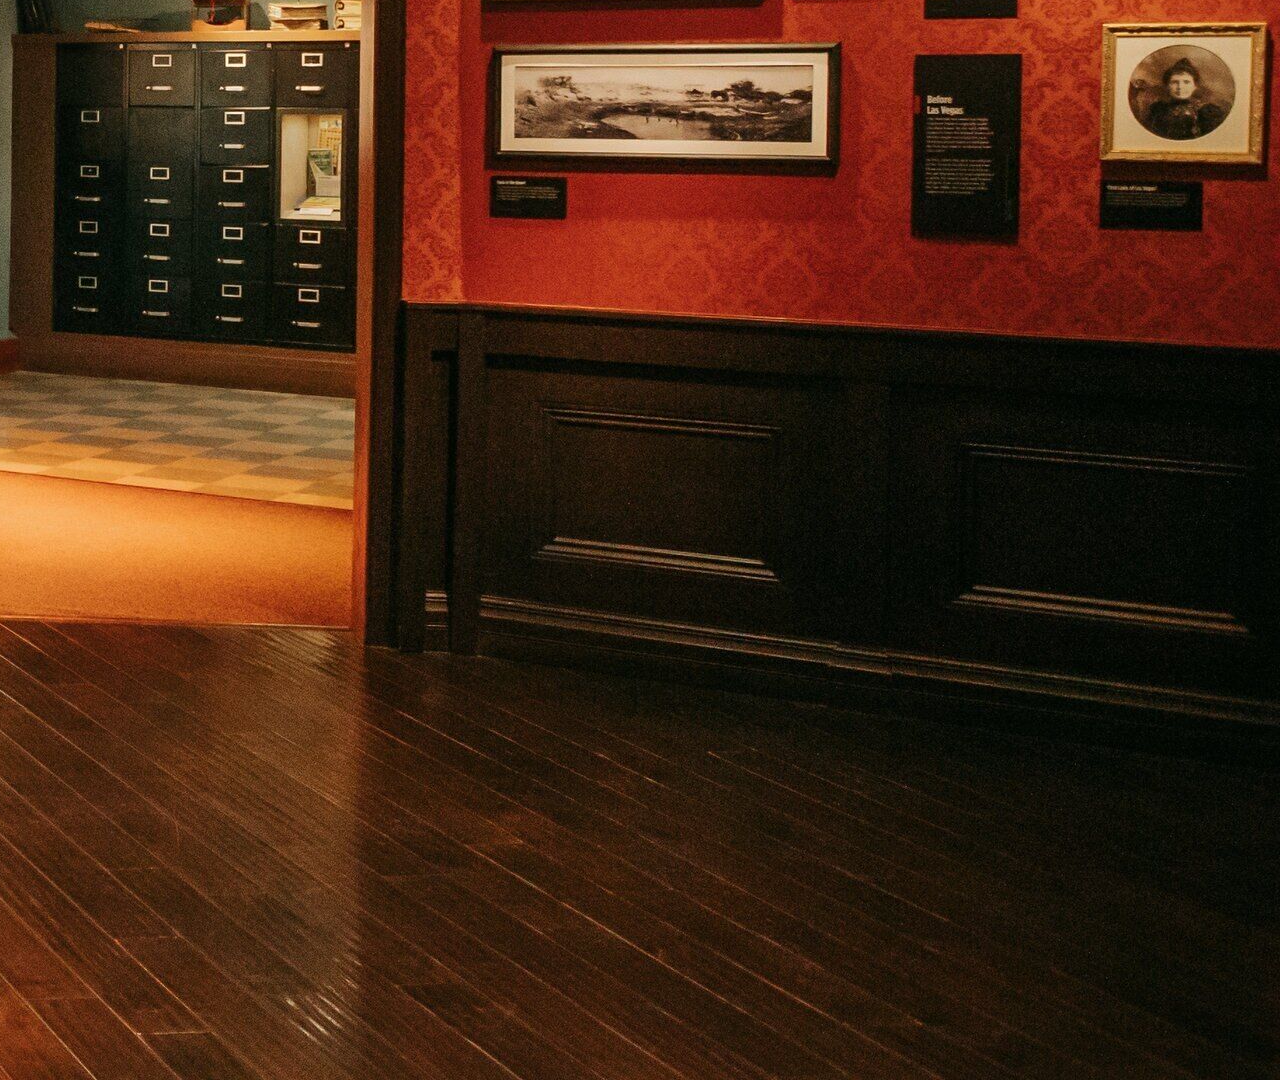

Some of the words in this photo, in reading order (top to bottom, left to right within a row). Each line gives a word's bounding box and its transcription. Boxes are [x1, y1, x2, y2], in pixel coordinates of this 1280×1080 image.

[926, 95, 953, 104] Before
[926, 106, 940, 115] Las
[941, 106, 964, 116] Vegas
